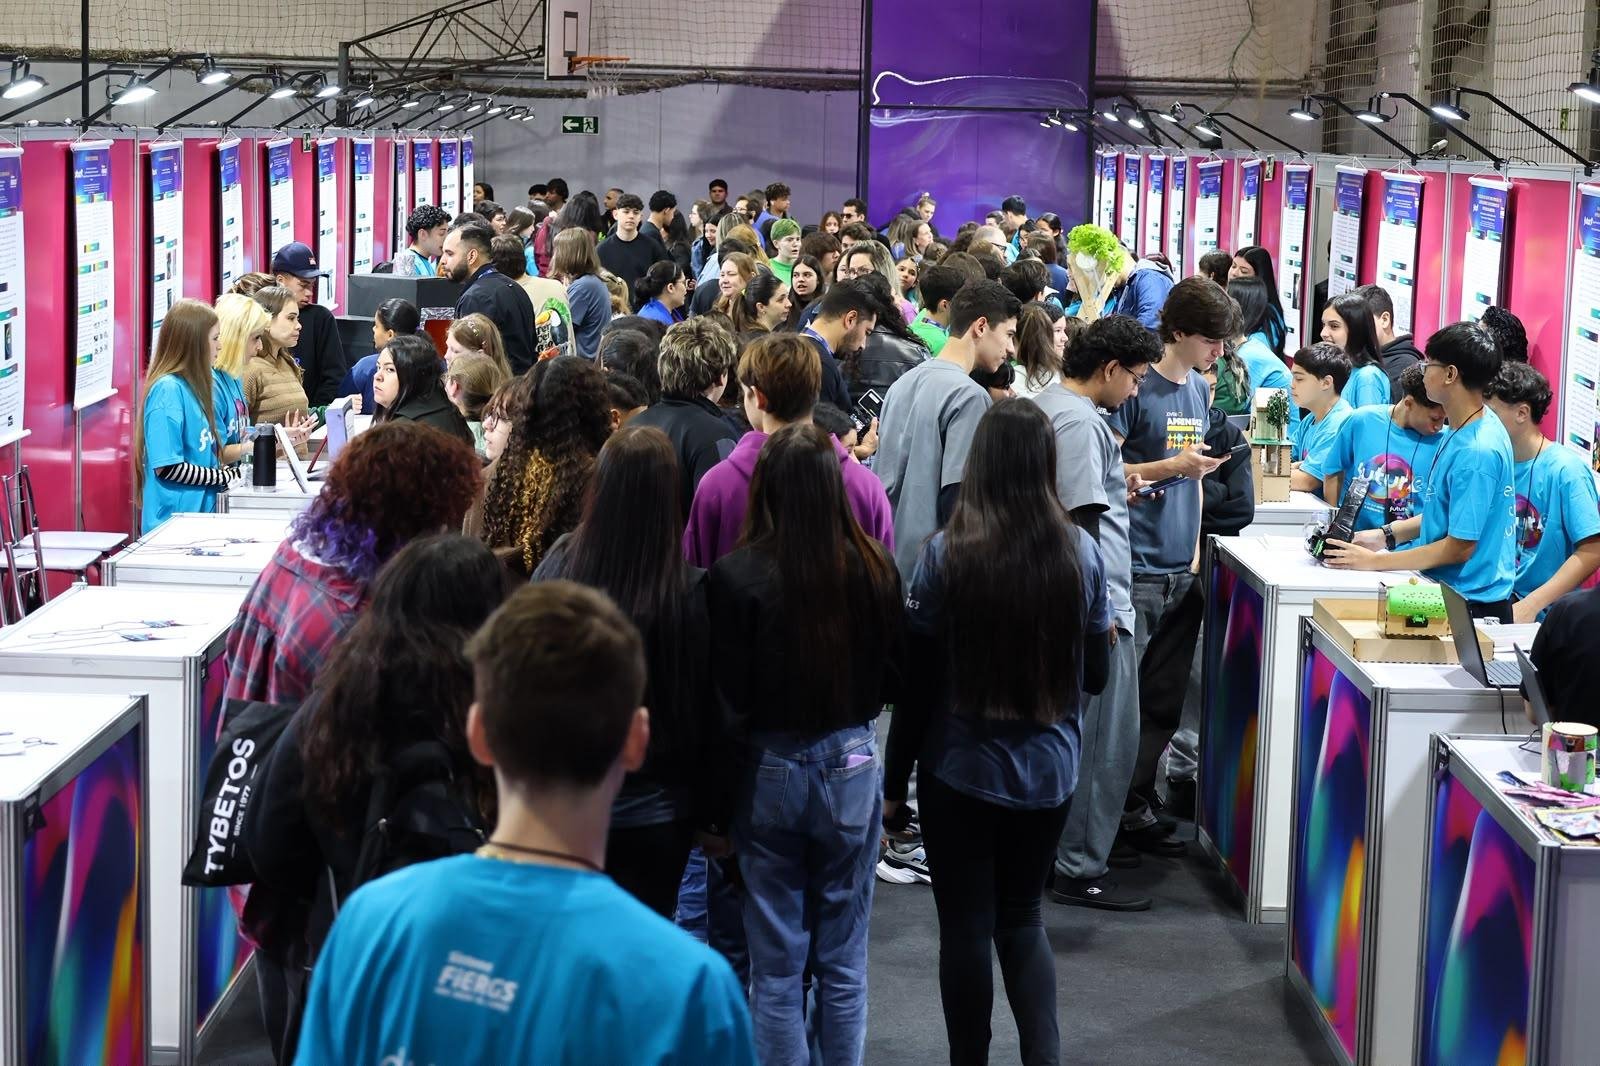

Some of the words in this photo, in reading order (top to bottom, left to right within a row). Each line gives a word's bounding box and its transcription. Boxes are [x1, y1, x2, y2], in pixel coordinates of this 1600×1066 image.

[204, 738, 256, 875] TYBETOS
[238, 785, 252, 809] 1977
[233, 811, 245, 837] SINCE
